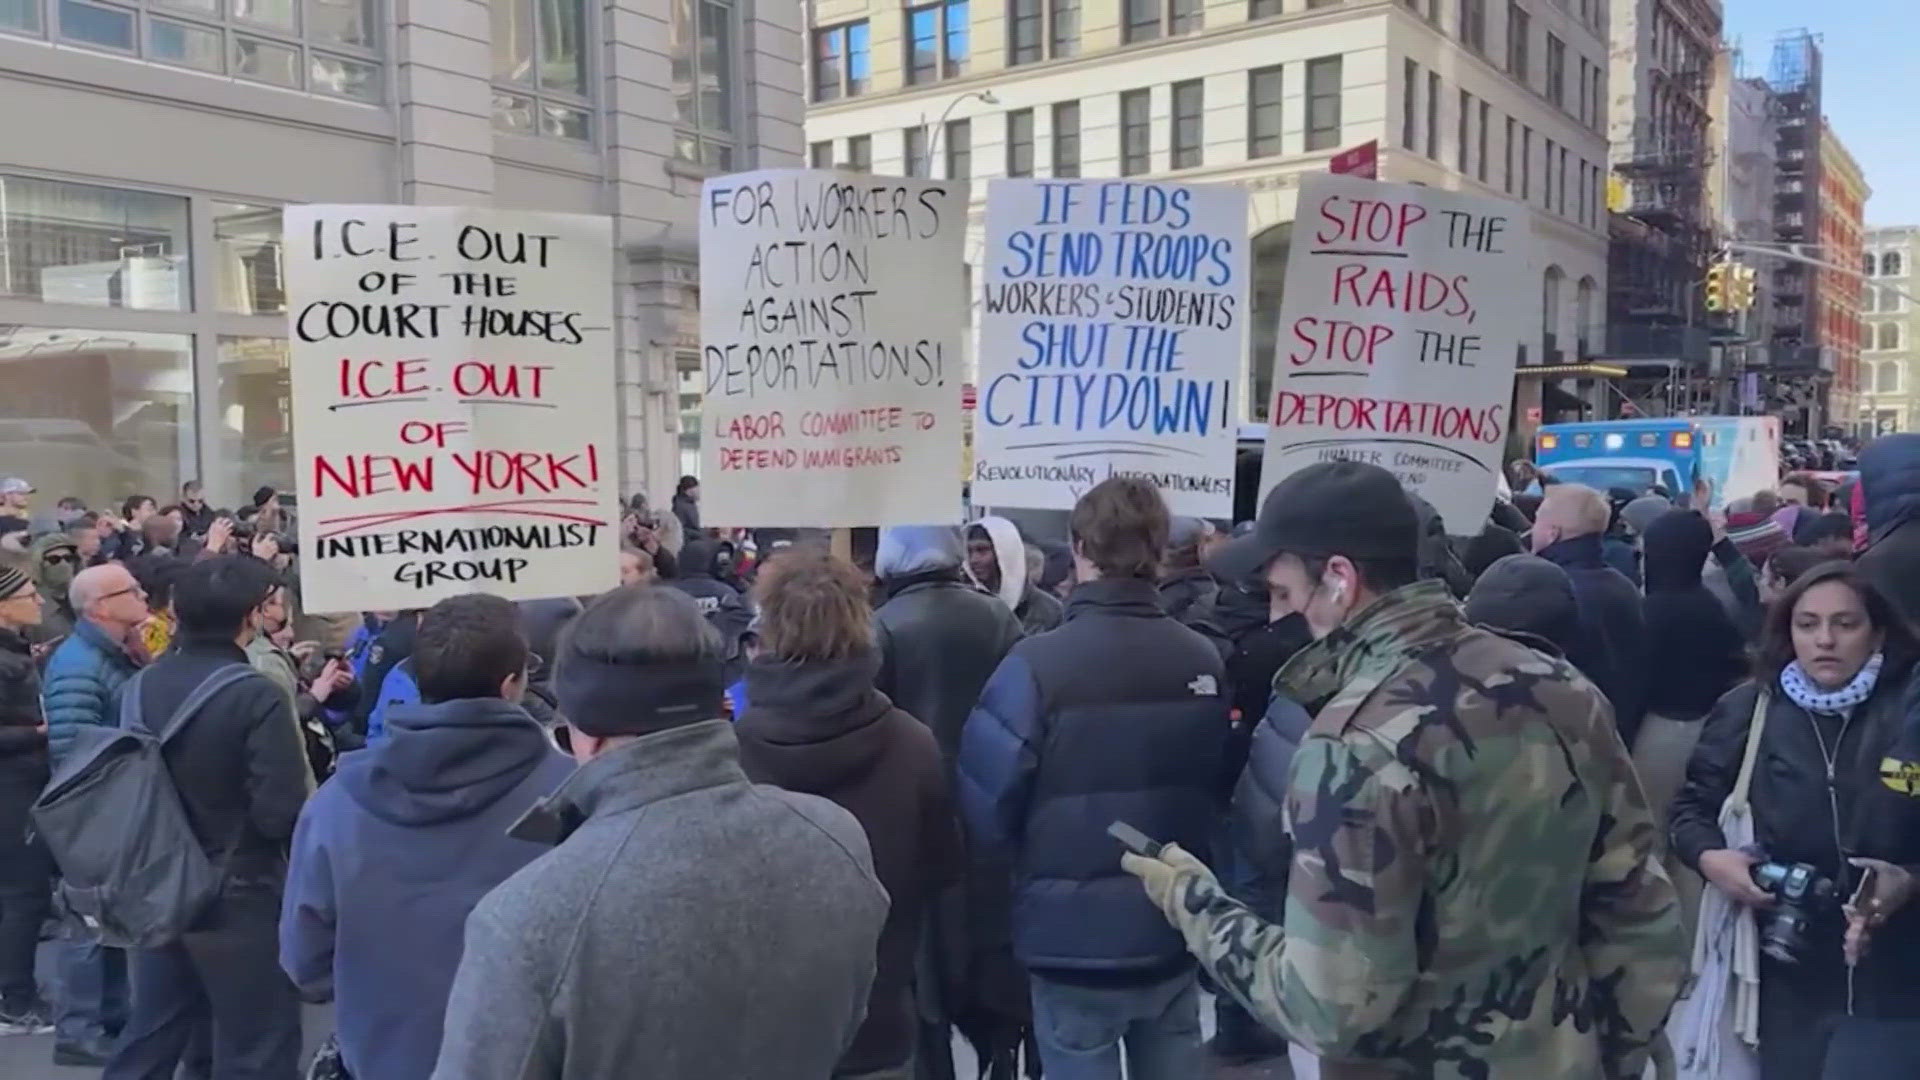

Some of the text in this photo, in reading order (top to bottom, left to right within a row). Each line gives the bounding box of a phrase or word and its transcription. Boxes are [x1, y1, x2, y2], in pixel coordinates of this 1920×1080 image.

[711, 178, 946, 240] FOR WORKERS
[1035, 182, 1191, 230] IF FEDS
[1316, 195, 1507, 253] STOP THE
[457, 225, 559, 267] OUT
[745, 241, 869, 290] ACTION
[1002, 231, 1232, 287] SEND TROOPS
[358, 271, 518, 297] OF THE
[985, 281, 1100, 318] WORKERS
[1114, 285, 1235, 330] STUDENTS
[1333, 263, 1476, 324] RAIDS,
[297, 301, 451, 342] COURT
[740, 290, 877, 338] AGAINST
[1018, 322, 1190, 373] SHUT THE
[1289, 317, 1481, 367] STOP THE
[453, 361, 554, 398] OUT
[704, 339, 944, 398] DEPORTATIONS!
[715, 407, 936, 441] LABOR COMMITTEE TO
[985, 373, 1097, 431] CITY
[1275, 390, 1503, 444] DEPORTATIONS
[400, 421, 468, 448] OF
[720, 446, 902, 471] DEFEND IMMIGRANTS
[314, 443, 599, 498] NEW YORK!
[976, 460, 1096, 485] REVOLUTIONARY
[1393, 452, 1464, 473] COMMITTEE
[316, 523, 599, 559] INTERNATIONALIST
[394, 558, 528, 589] GROUP
